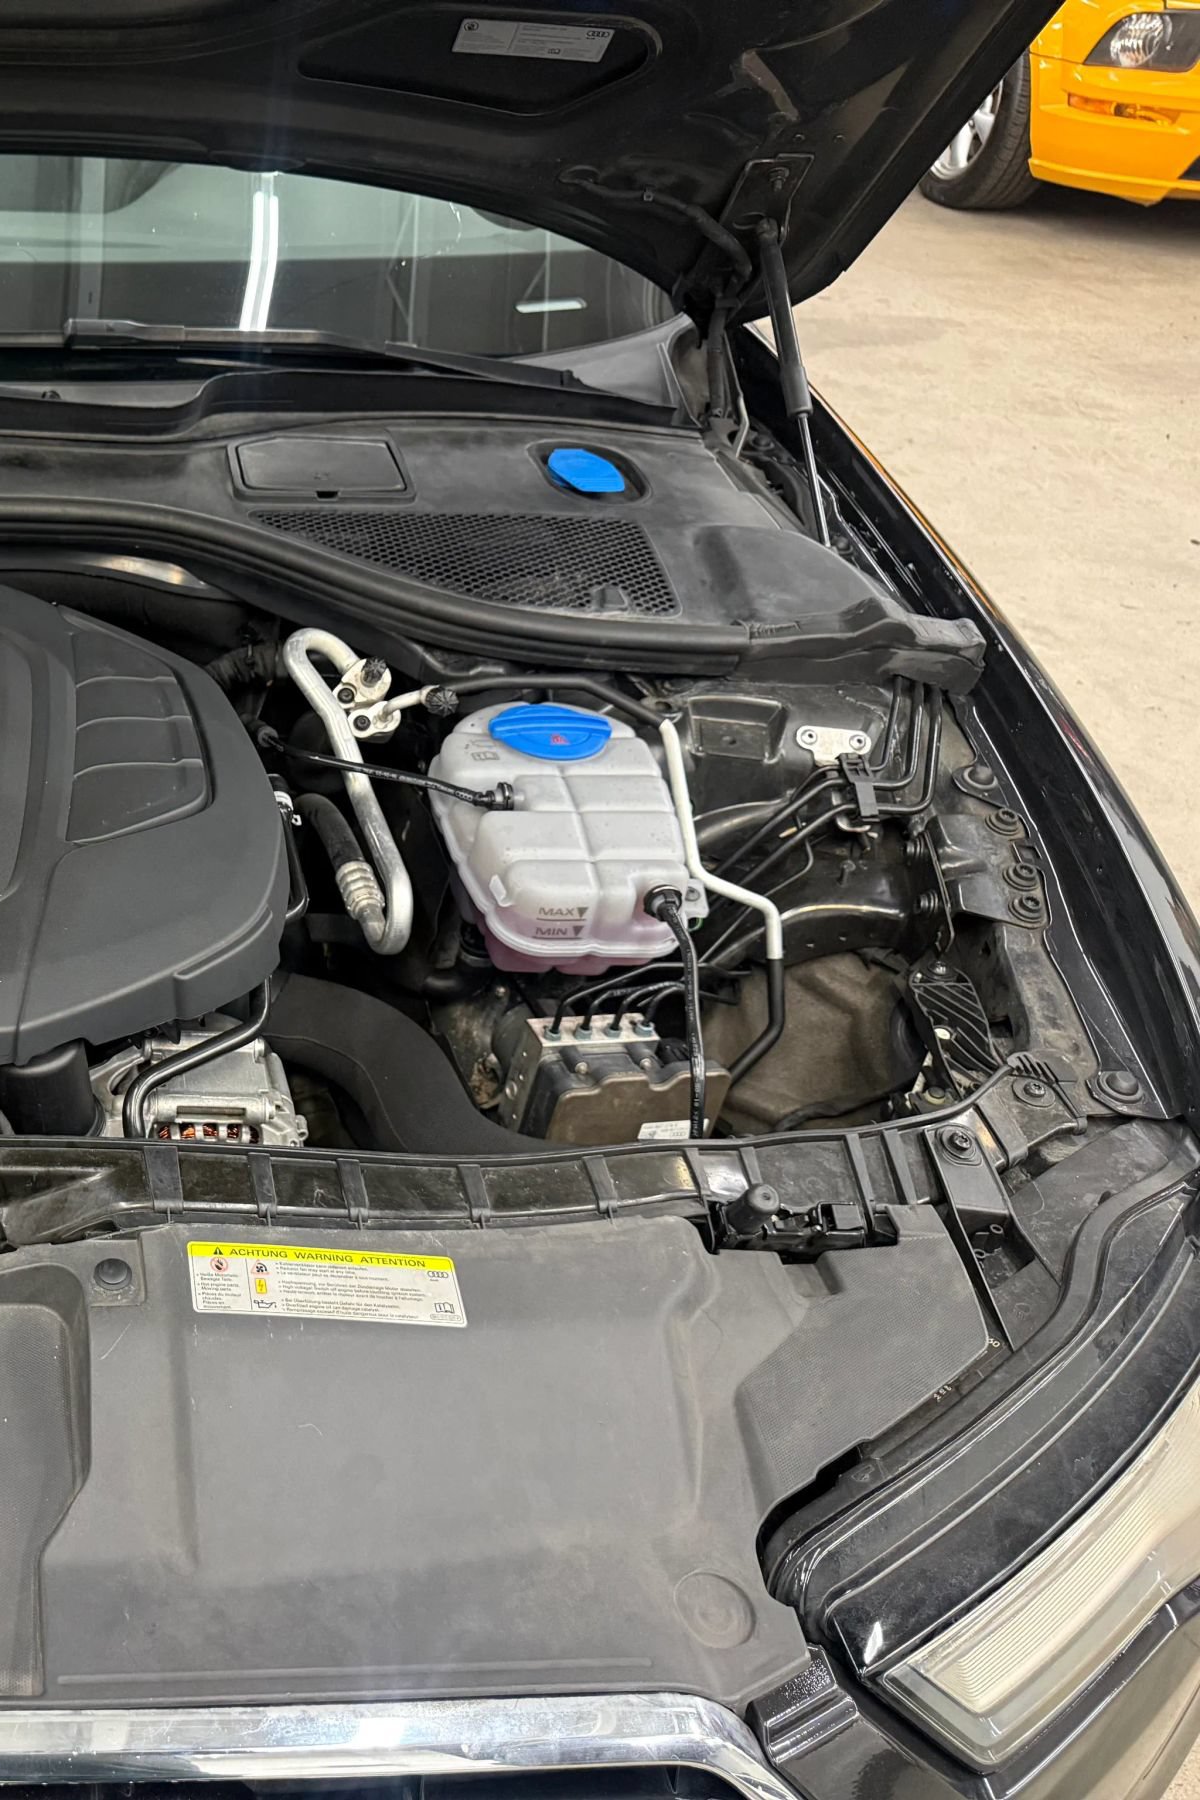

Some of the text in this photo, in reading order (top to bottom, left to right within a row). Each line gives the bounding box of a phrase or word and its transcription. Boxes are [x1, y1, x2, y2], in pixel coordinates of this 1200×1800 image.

[538, 906, 576, 918] MAX
[535, 926, 569, 937] MIN
[229, 1248, 288, 1259] ACHTUNG
[294, 1252, 353, 1263] WARNING
[360, 1255, 426, 1268] ATTENTION
